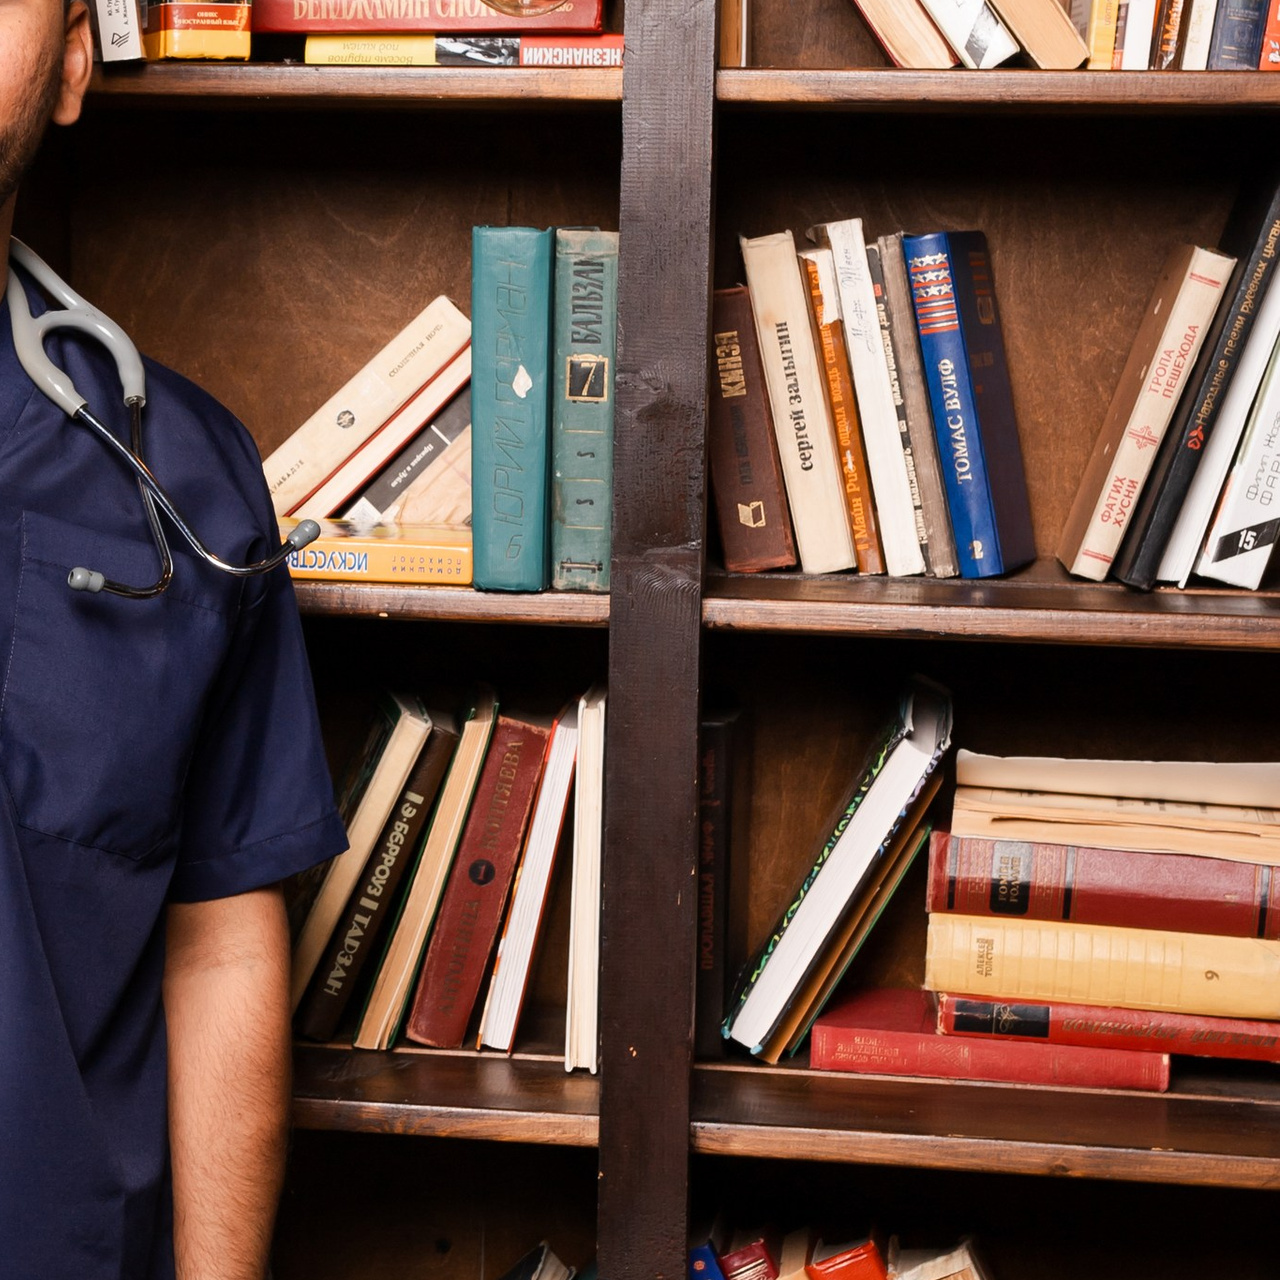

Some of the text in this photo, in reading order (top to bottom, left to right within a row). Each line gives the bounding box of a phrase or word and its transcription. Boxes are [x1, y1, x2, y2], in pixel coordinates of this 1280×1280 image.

[385, 340, 426, 380] СОЛНЕЧНАЯ
[713, 329, 747, 398] КИНЗЯ
[1146, 344, 1175, 396] ТРОПА
[1160, 320, 1201, 400] ПЕШЕХОДА
[1194, 356, 1231, 425] Народные
[1221, 312, 1247, 357] песни
[1238, 258, 1269, 314] русских
[579, 360, 598, 397] 7
[773, 320, 816, 472] сергей залыгин
[825, 365, 853, 447] ОЦЕОЛА ВОЖДЬ
[406, 440, 435, 469] Призрак
[935, 355, 973, 485] ТОМАС ВУЛФ
[491, 415, 526, 526] ЮРИЙ
[838, 454, 870, 538] Майн Рид
[1098, 472, 1128, 525] ФАТИХ
[1111, 475, 1141, 528] ХУСНИ
[389, 554, 462, 564] ПСИХОЛОГ
[389, 564, 461, 574] ДОМАШНИЙ
[1238, 528, 1261, 552] 15
[472, 735, 536, 853] КОПТЯЕВА
[316, 907, 380, 998] ТАРЗАН
[699, 871, 715, 970] ПРОПАВШАЯ
[426, 896, 490, 1018] АНТОНИНА
[972, 937, 988, 977] АЛЕКСЕЙ
[982, 938, 996, 978] ТОЛСТОЙ
